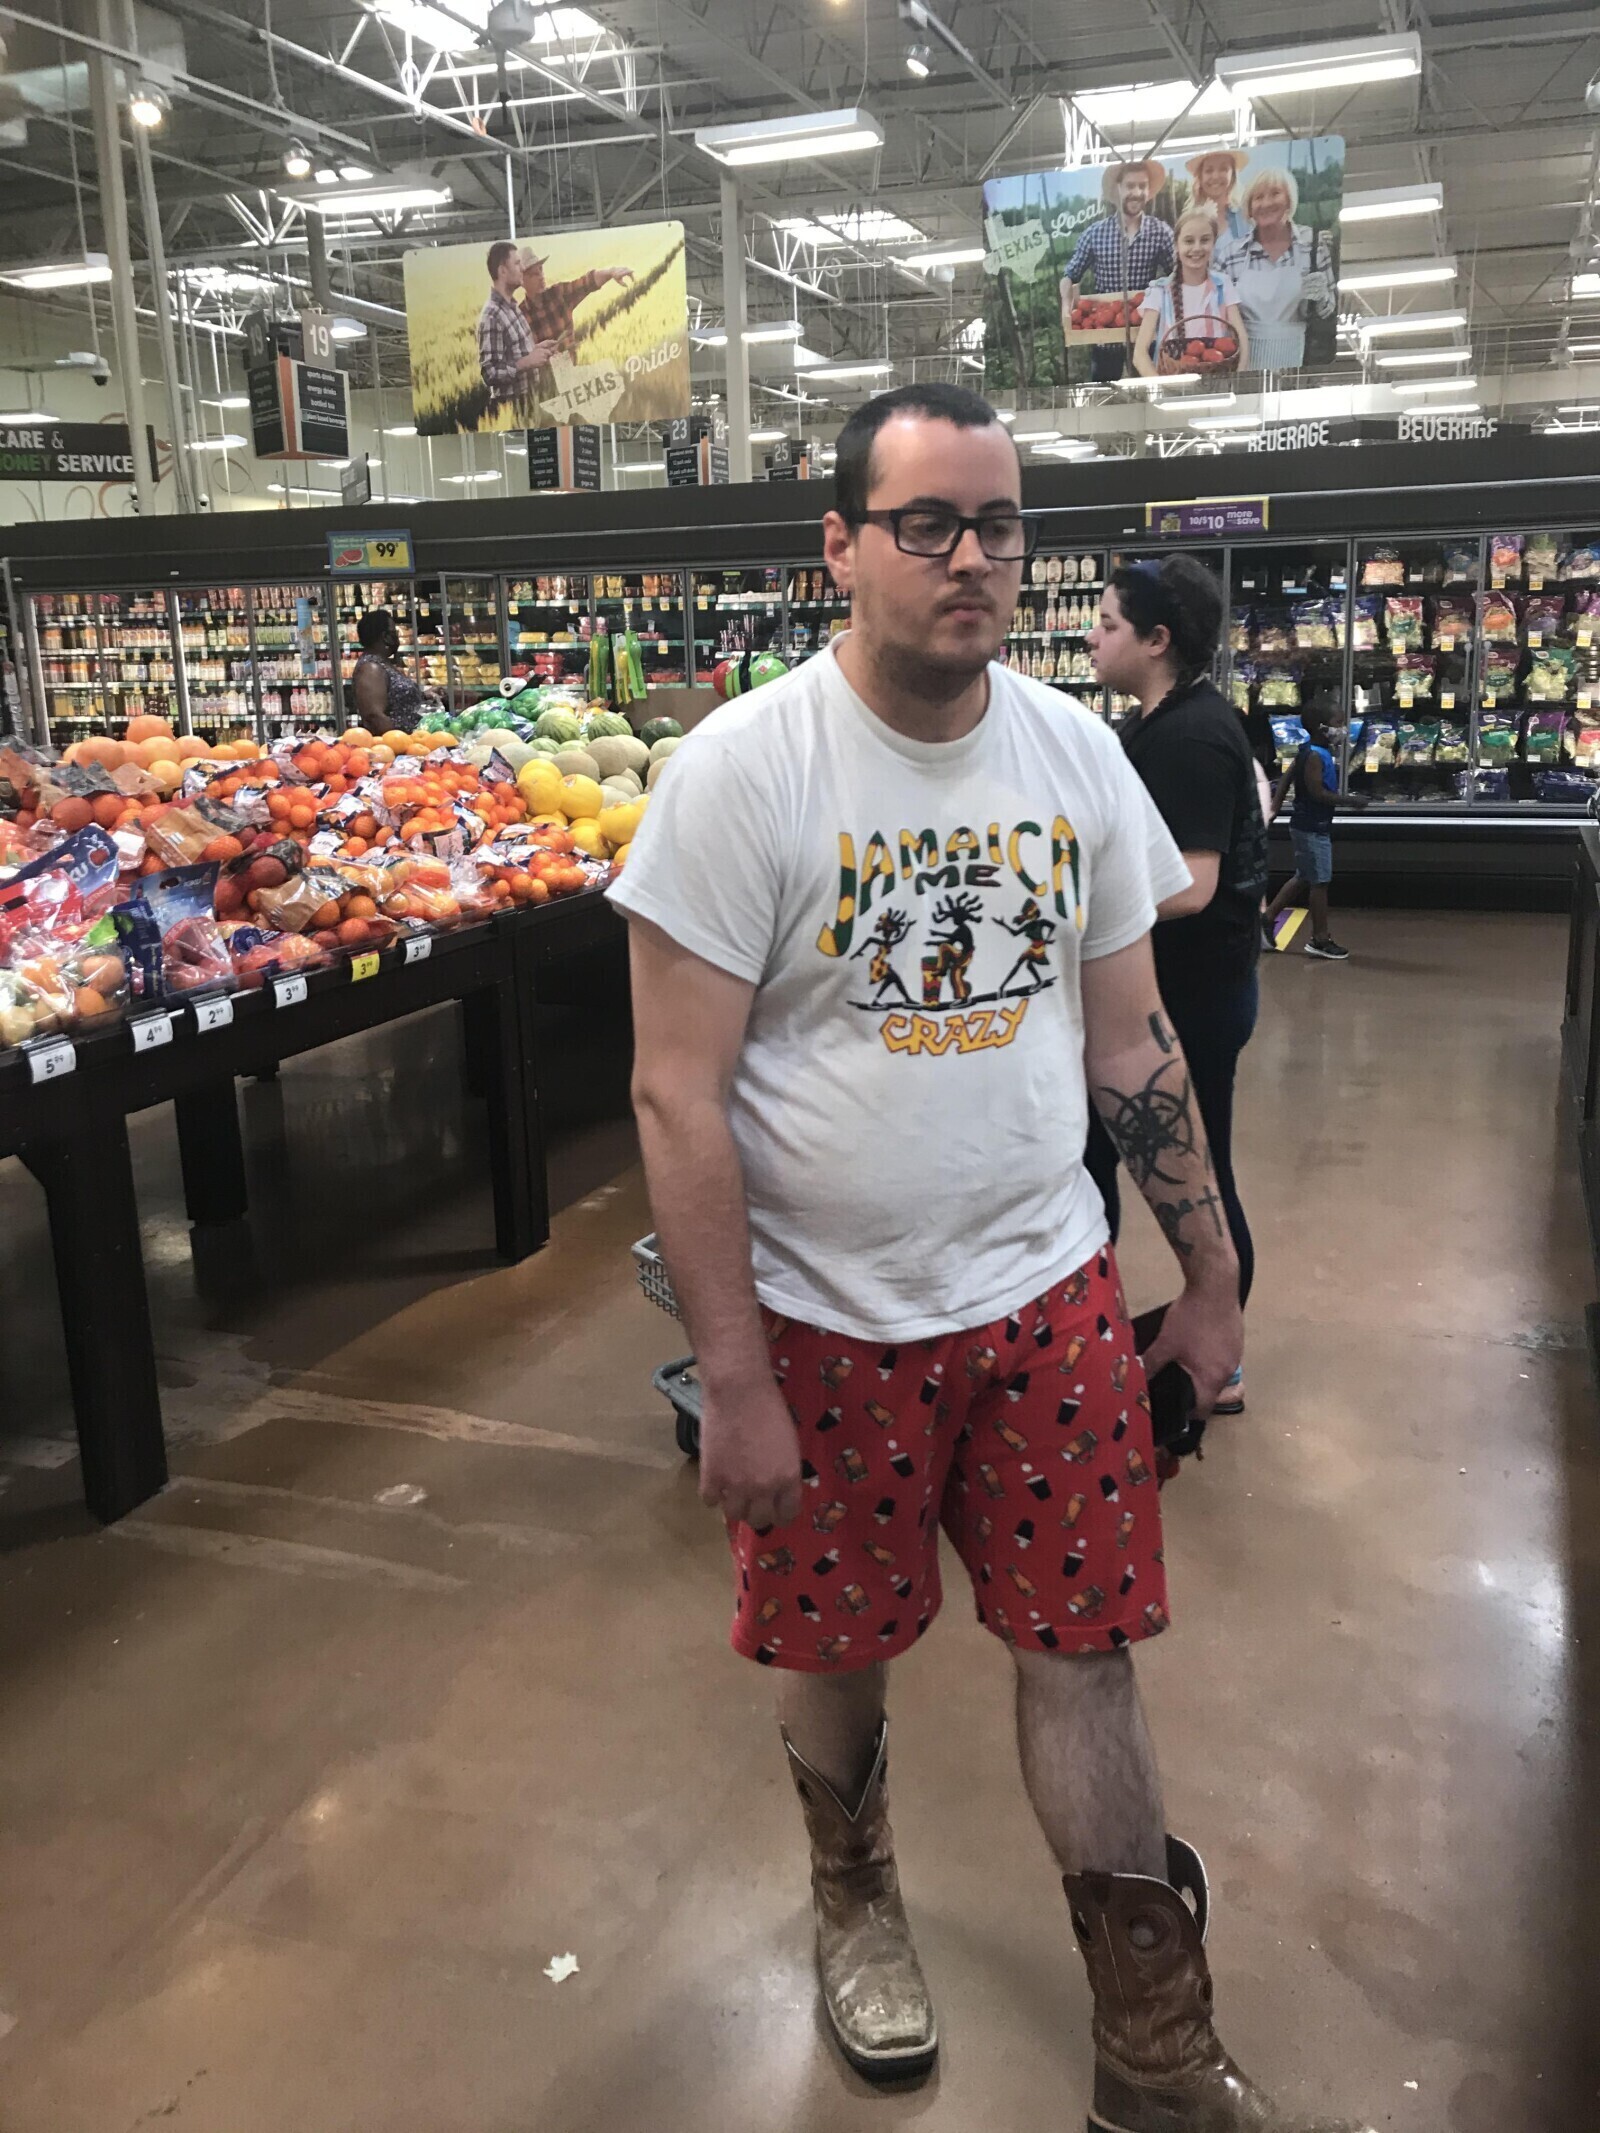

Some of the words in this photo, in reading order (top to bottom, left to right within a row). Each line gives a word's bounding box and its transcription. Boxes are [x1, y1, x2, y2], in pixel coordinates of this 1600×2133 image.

[988, 231, 1043, 263] TEXAS
[1051, 197, 1105, 238] Local
[309, 324, 329, 357] 19
[562, 372, 617, 409] TEXAS
[625, 342, 682, 382] Pride
[51, 431, 64, 449] &
[672, 418, 687, 440] 23
[0, 454, 51, 472] ONEY
[775, 443, 788, 461] 25
[1227, 510, 1253, 518] more
[1237, 517, 1260, 525] save
[816, 815, 1083, 957] JAMAICA
[915, 864, 1002, 895] ME
[880, 998, 1029, 1056] CRAZY
